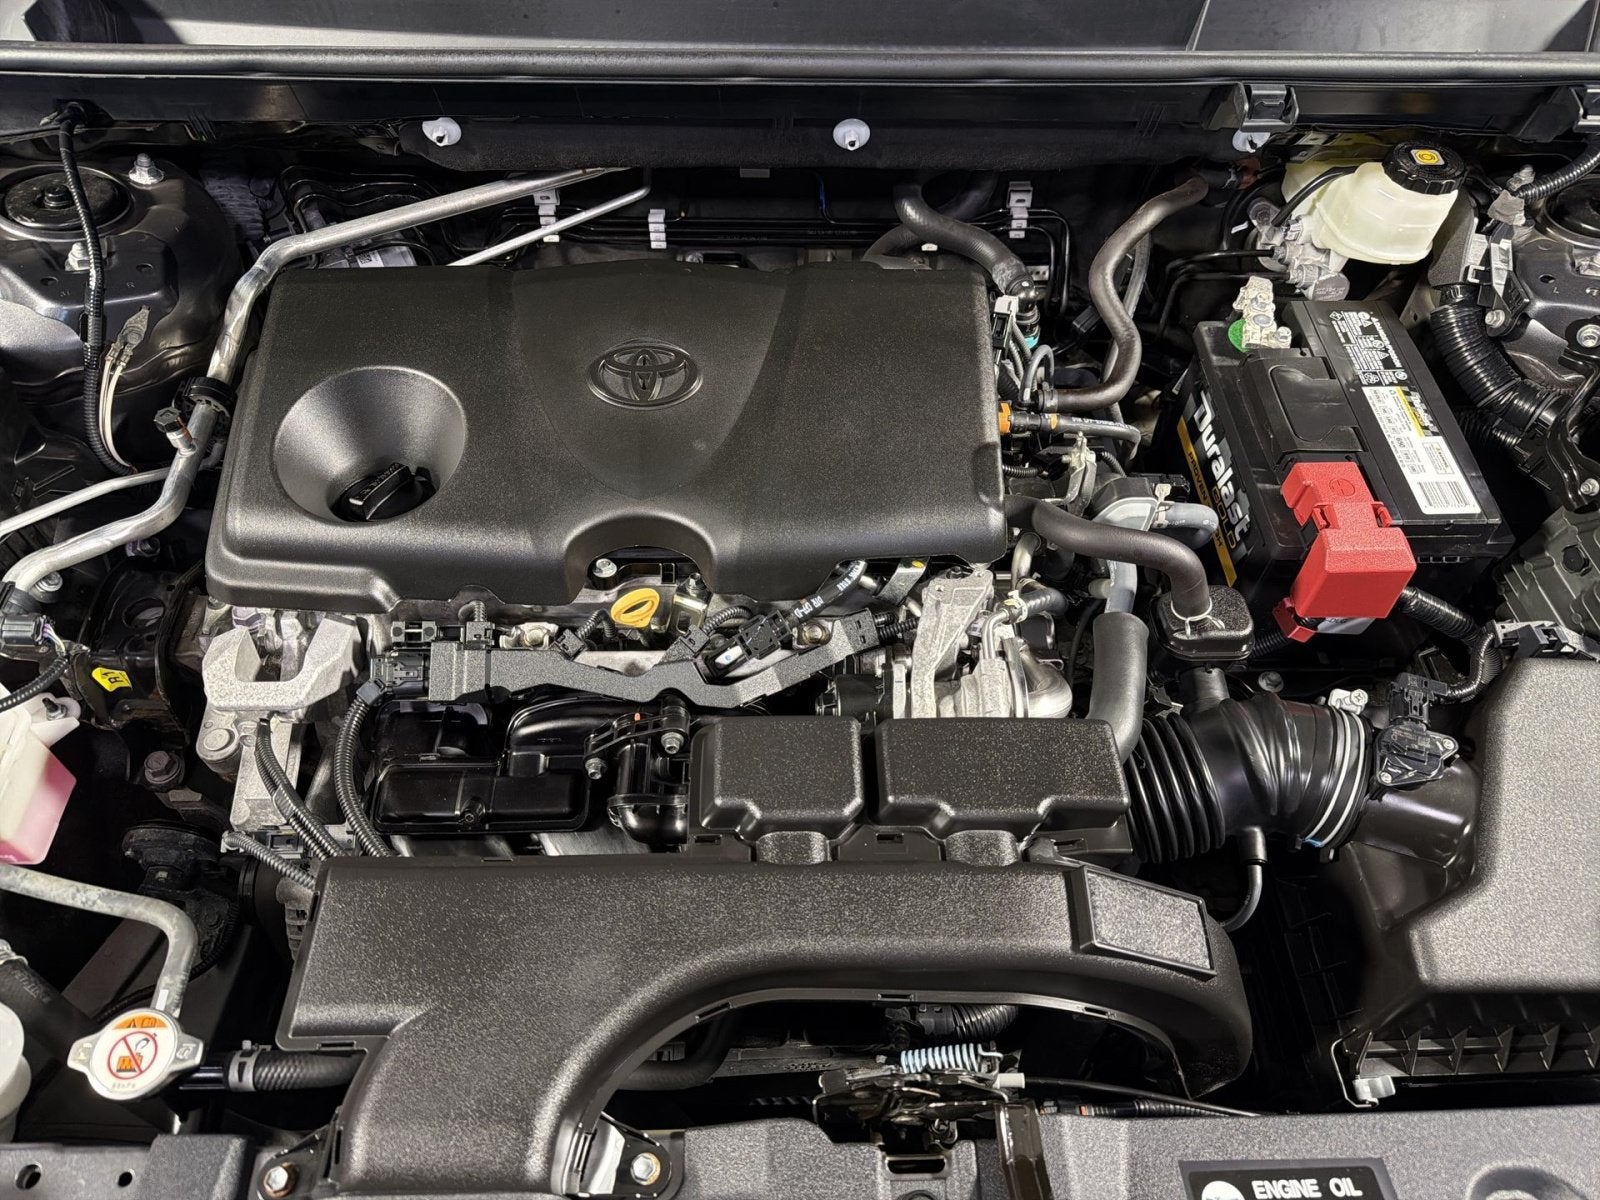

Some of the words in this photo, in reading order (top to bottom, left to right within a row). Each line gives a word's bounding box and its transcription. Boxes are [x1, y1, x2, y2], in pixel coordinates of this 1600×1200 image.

[1187, 451, 1208, 505] PROVEN
[1193, 389, 1251, 542] Duralast
[1212, 484, 1237, 549] GOLD
[1251, 1179, 1322, 1199] ENGINE
[1328, 1177, 1363, 1198] OIL
